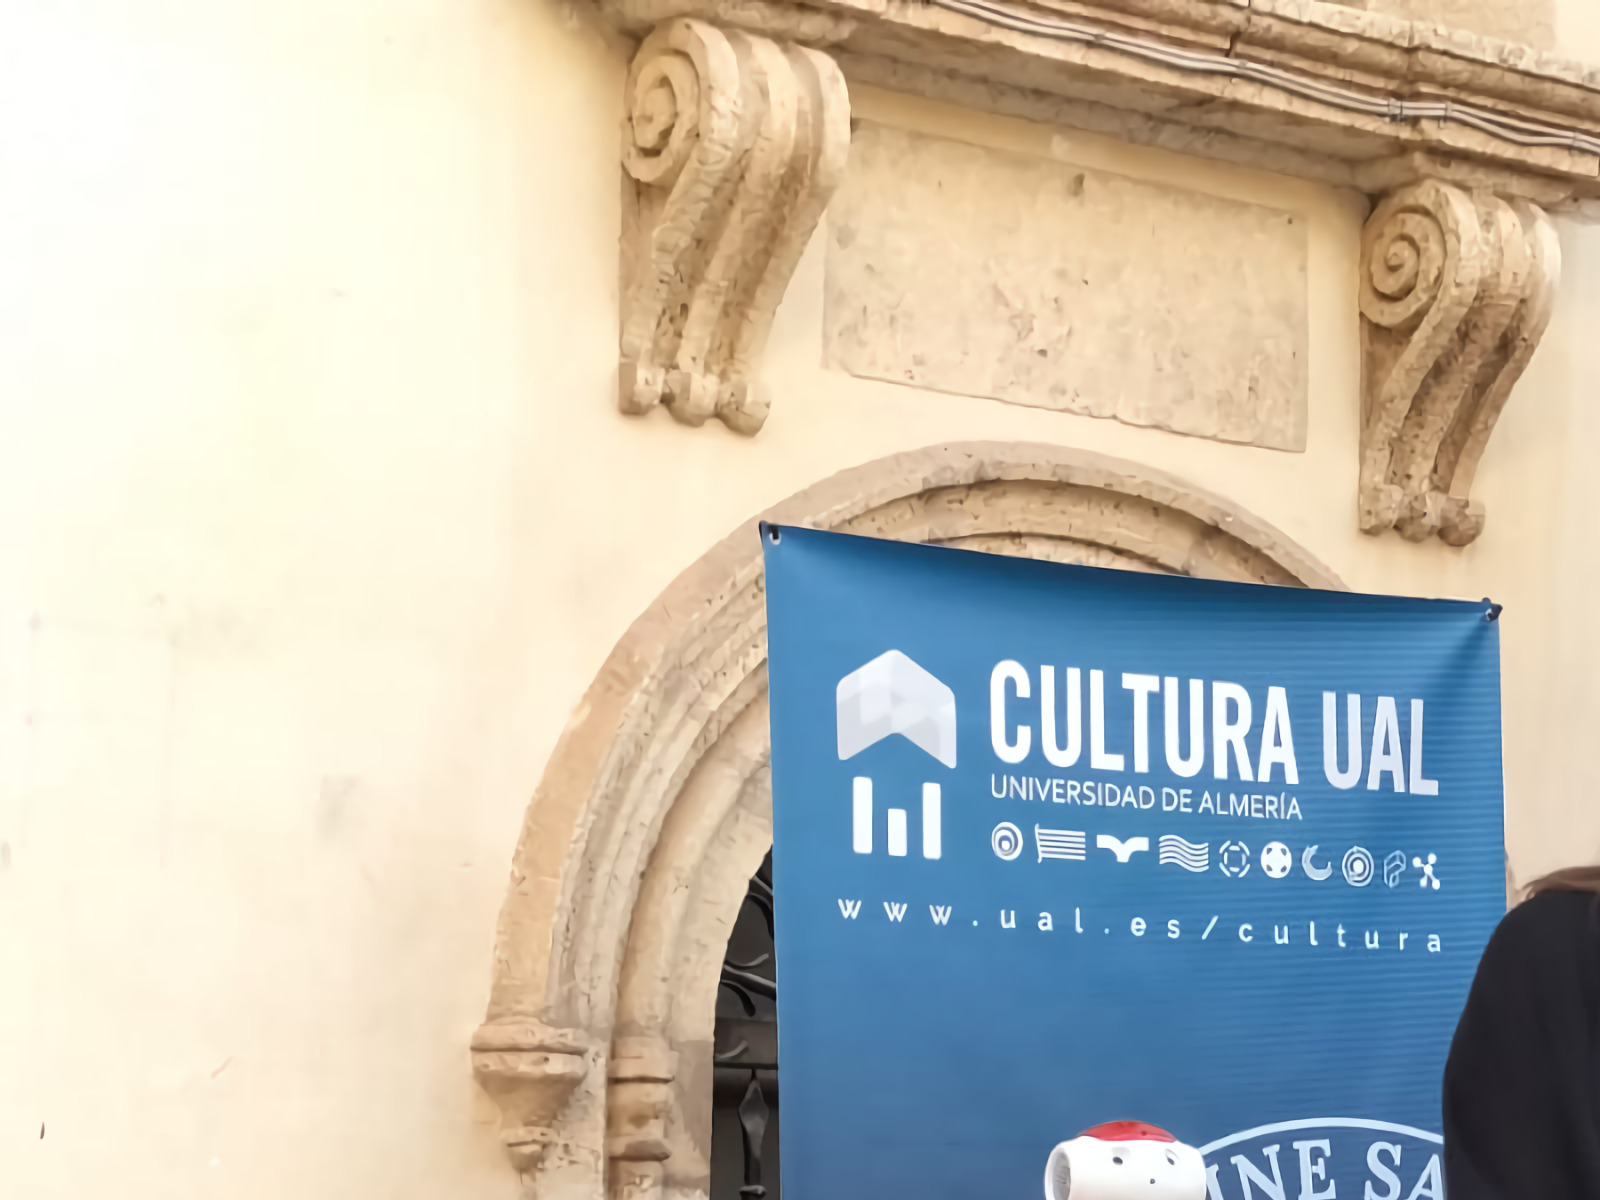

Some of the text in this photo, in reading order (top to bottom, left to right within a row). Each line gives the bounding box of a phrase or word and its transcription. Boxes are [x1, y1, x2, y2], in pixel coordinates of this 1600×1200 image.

[989, 658, 1440, 796] CULTURA UAL
[990, 772, 1303, 821] UNIVERSIDAD DE ALMERÍA
